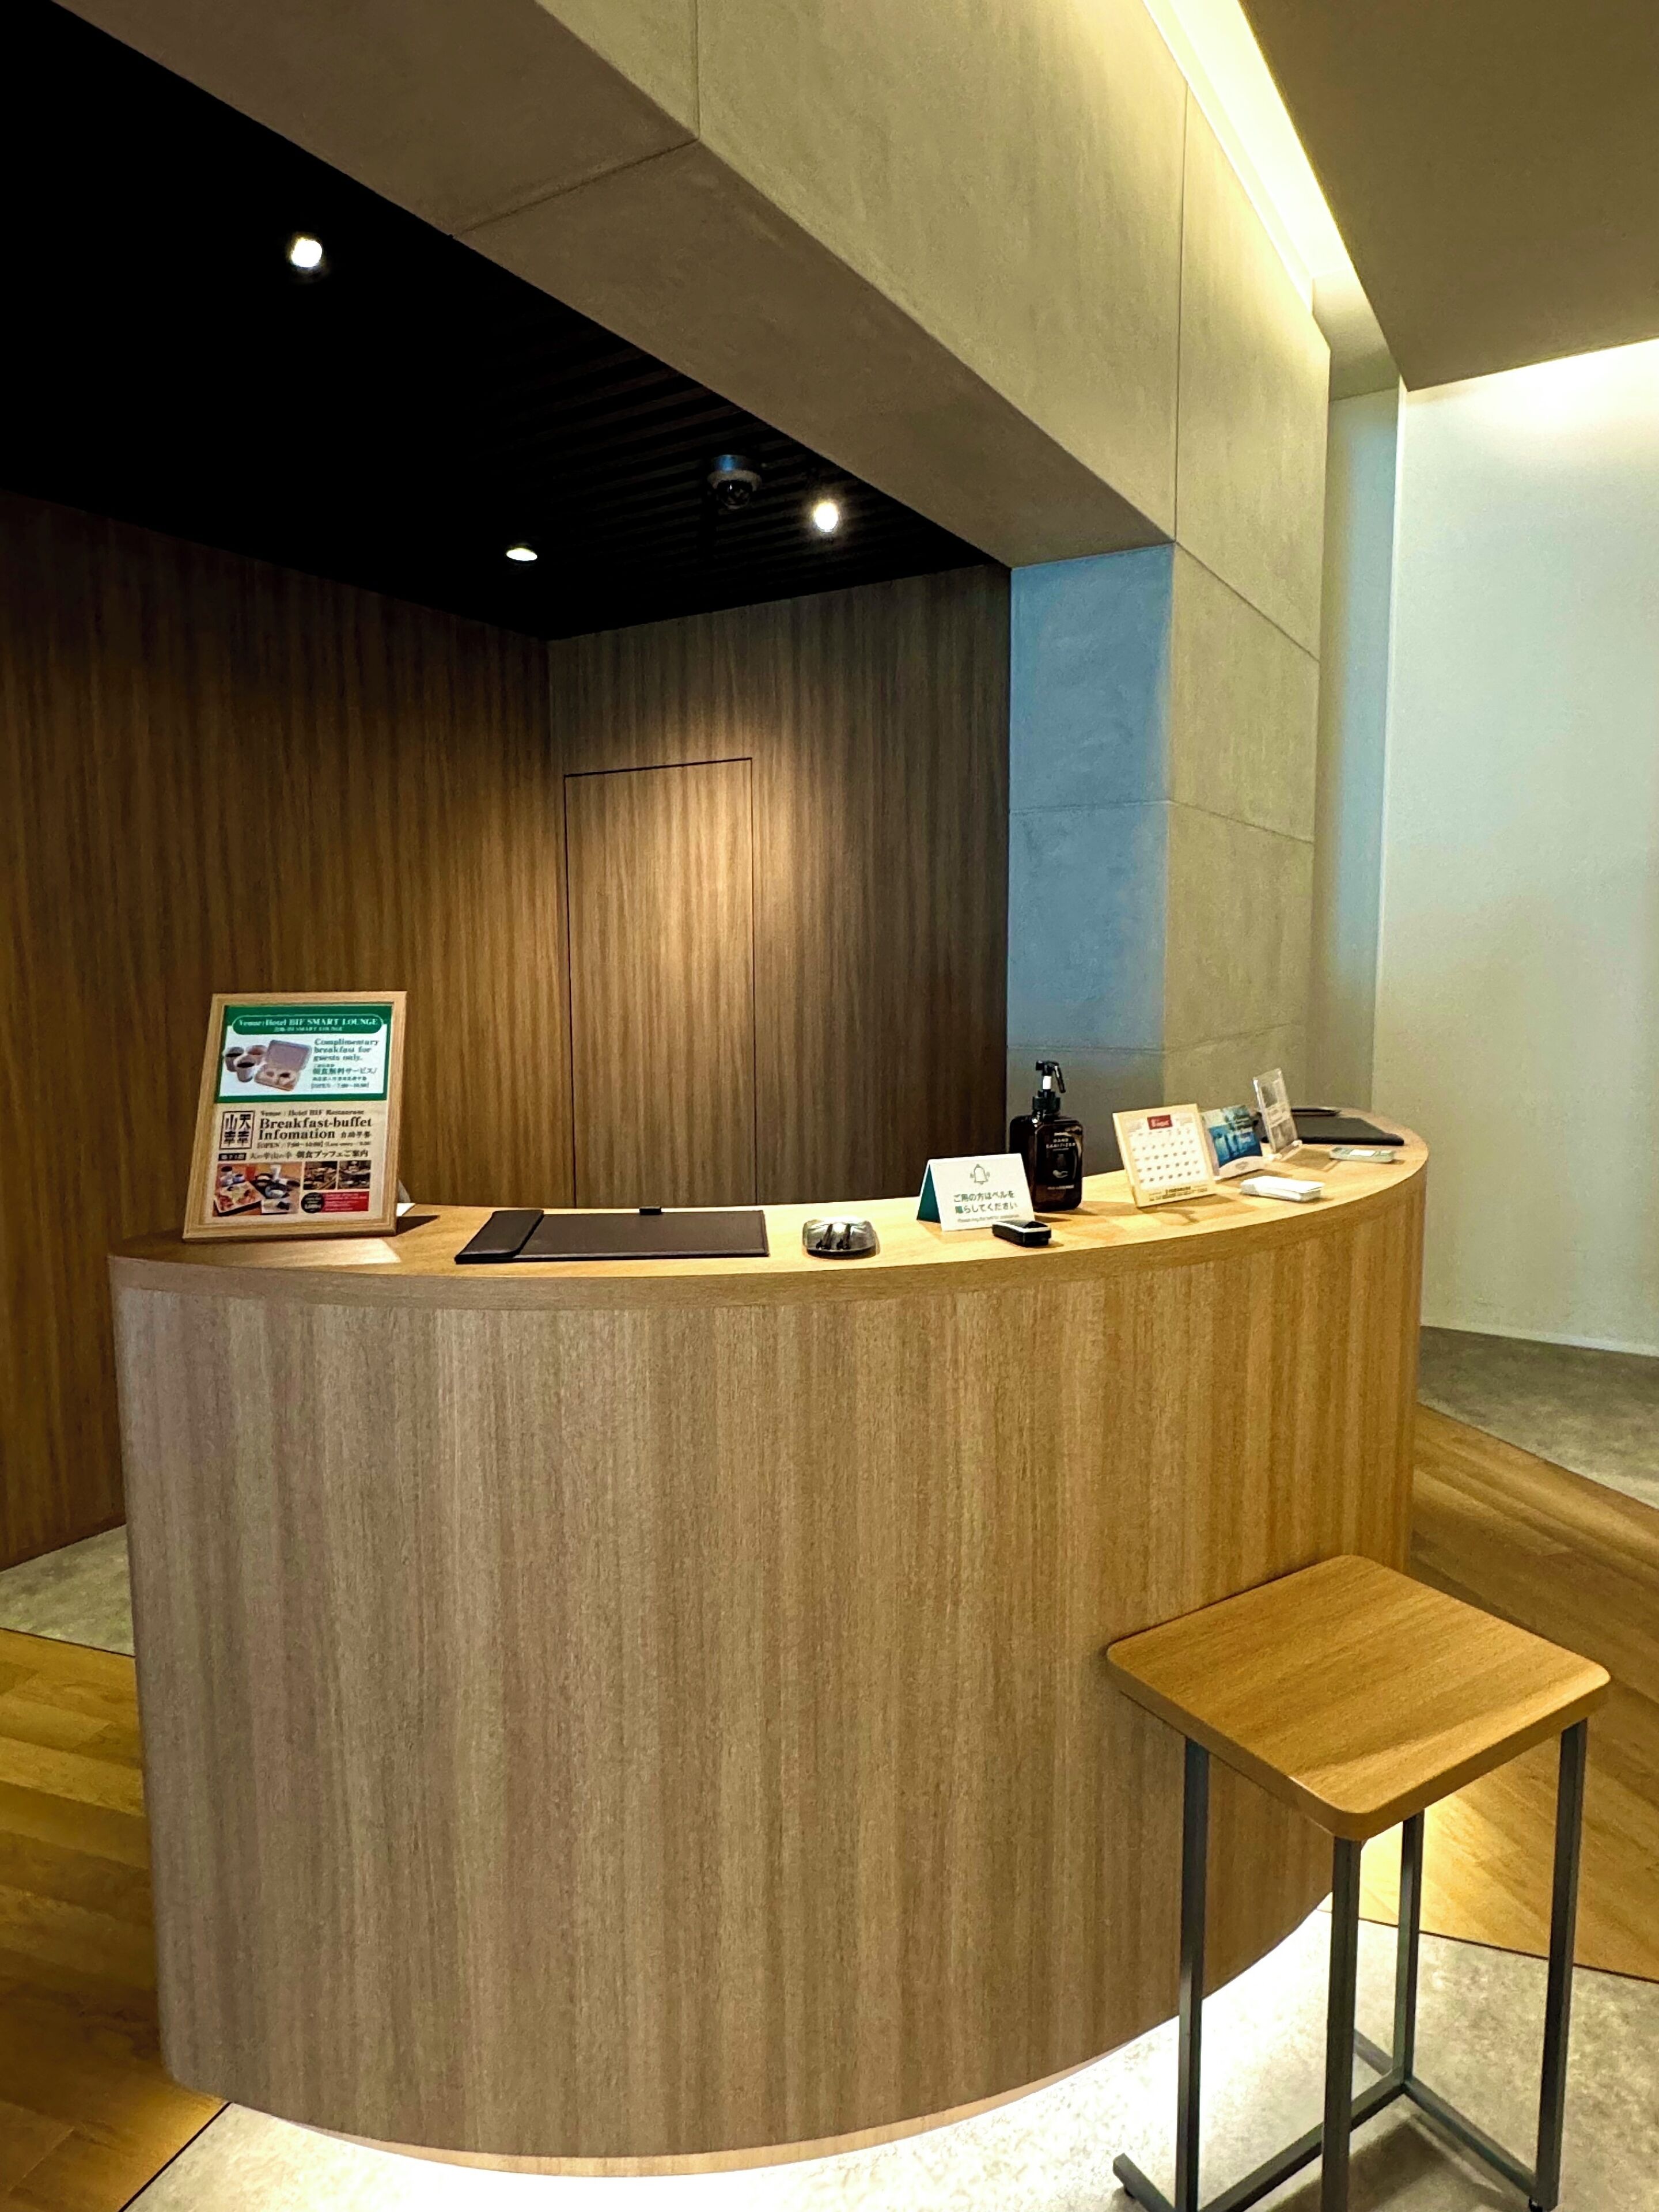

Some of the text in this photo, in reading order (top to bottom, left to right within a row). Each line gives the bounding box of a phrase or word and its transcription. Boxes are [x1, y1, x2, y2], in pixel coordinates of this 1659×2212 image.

[342, 1017, 378, 1025] LOUNGE
[314, 1038, 379, 1047] Complimentary
[259, 1116, 372, 1129] Breakfast-buffet
[258, 1128, 335, 1141] Infomation
